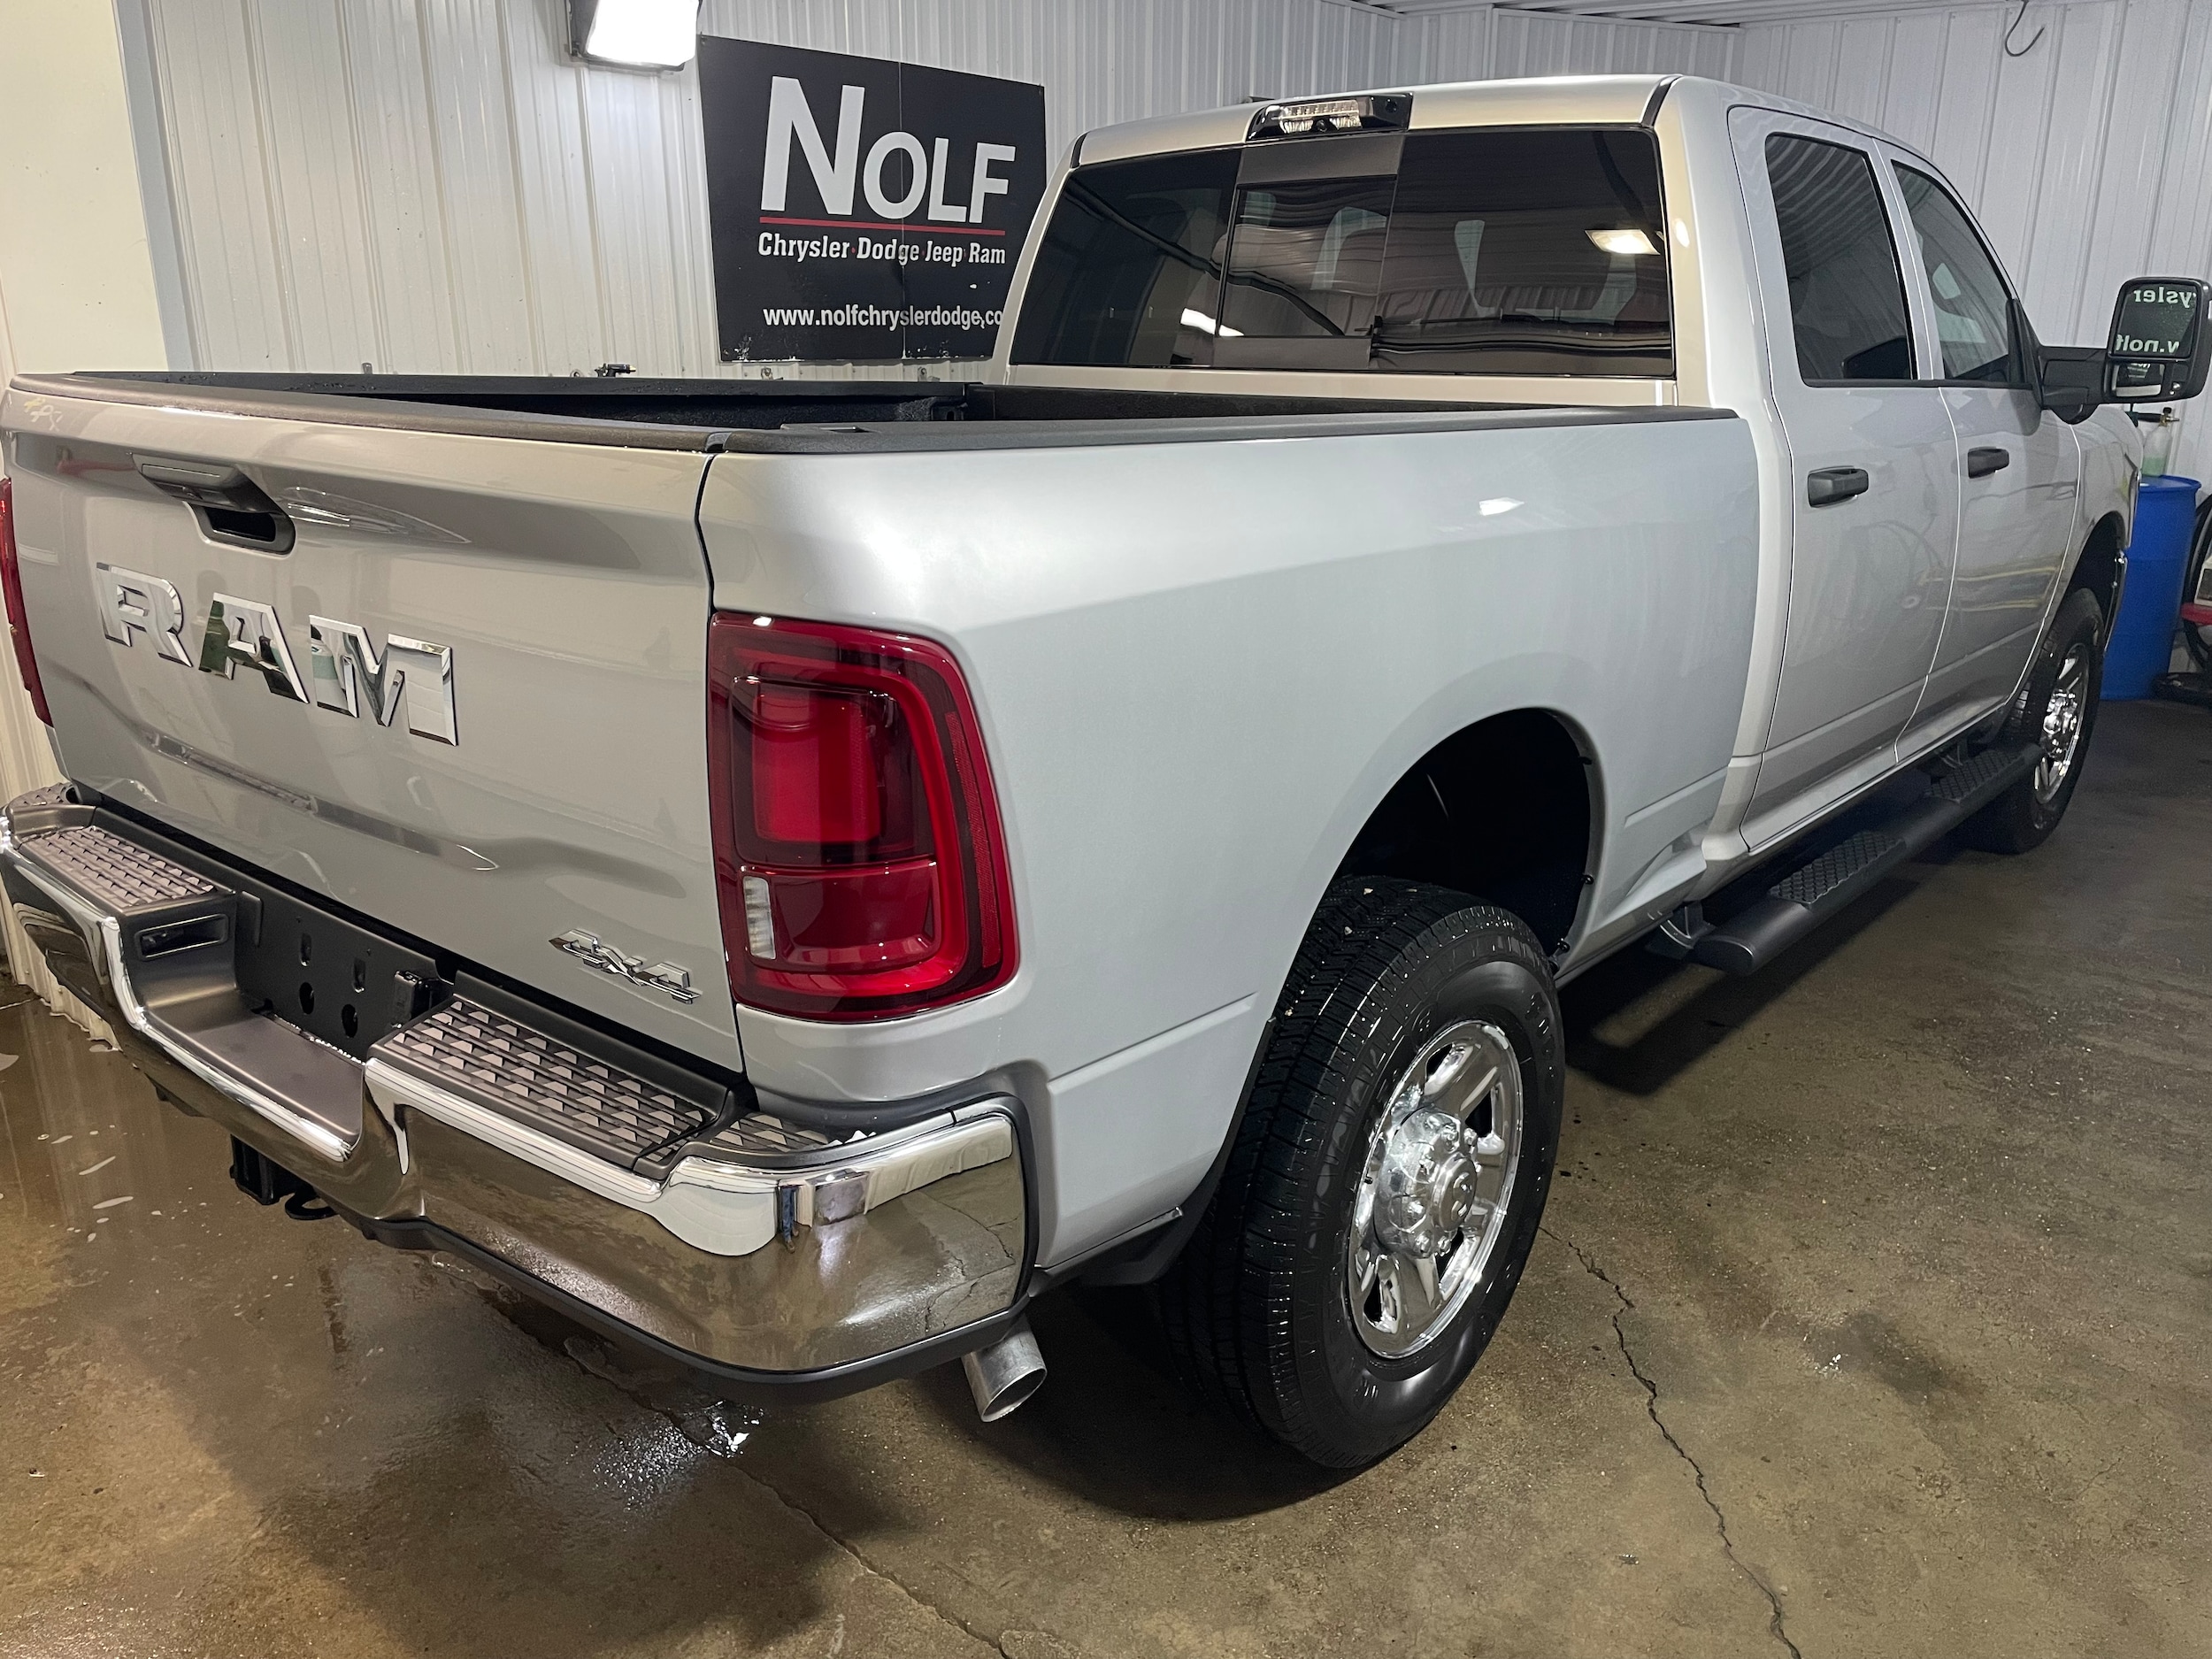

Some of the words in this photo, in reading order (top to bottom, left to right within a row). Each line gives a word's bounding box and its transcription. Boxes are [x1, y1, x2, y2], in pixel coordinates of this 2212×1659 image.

[761, 75, 1016, 223] NOLF
[757, 232, 850, 262] Chrysler
[856, 237, 919, 266] Dodge
[925, 240, 964, 267] Jeep
[969, 242, 1006, 264] Ram
[763, 303, 1002, 331] www.nolfchryslerdodge.co
[96, 562, 458, 747] RAM
